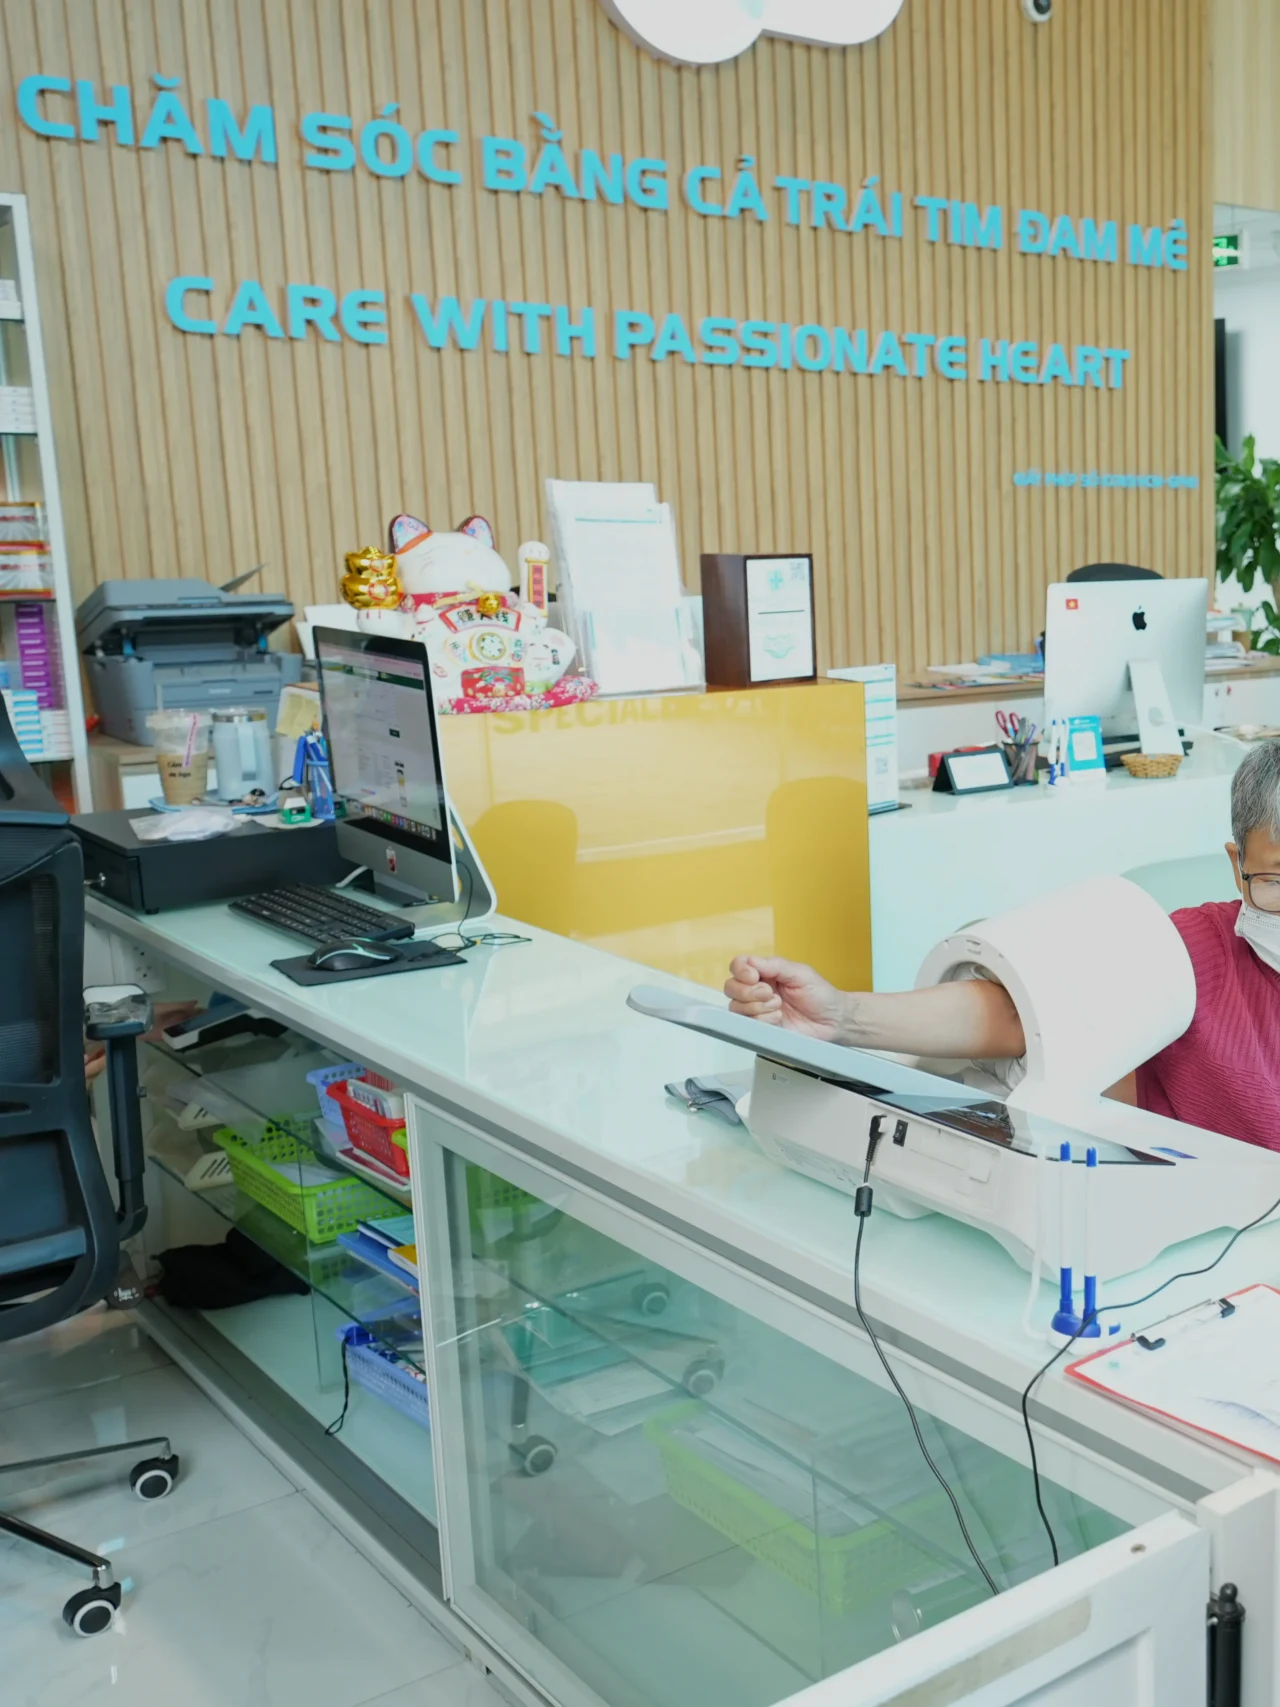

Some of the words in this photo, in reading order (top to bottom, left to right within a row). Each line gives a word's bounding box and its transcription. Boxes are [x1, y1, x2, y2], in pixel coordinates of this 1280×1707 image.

[18, 73, 278, 164] CHĂM
[301, 103, 462, 185] SÓC
[482, 111, 669, 210] BẰNG
[685, 154, 769, 221] CẢ
[774, 175, 903, 237] TRÁI
[915, 196, 1003, 250] TIM
[1016, 208, 1118, 263] ĐAM
[1128, 218, 1189, 271] MÊ
[165, 275, 388, 345] CARE
[411, 294, 597, 358] WITH
[614, 311, 968, 380] PASSIONATE
[980, 339, 1131, 389] HEART
